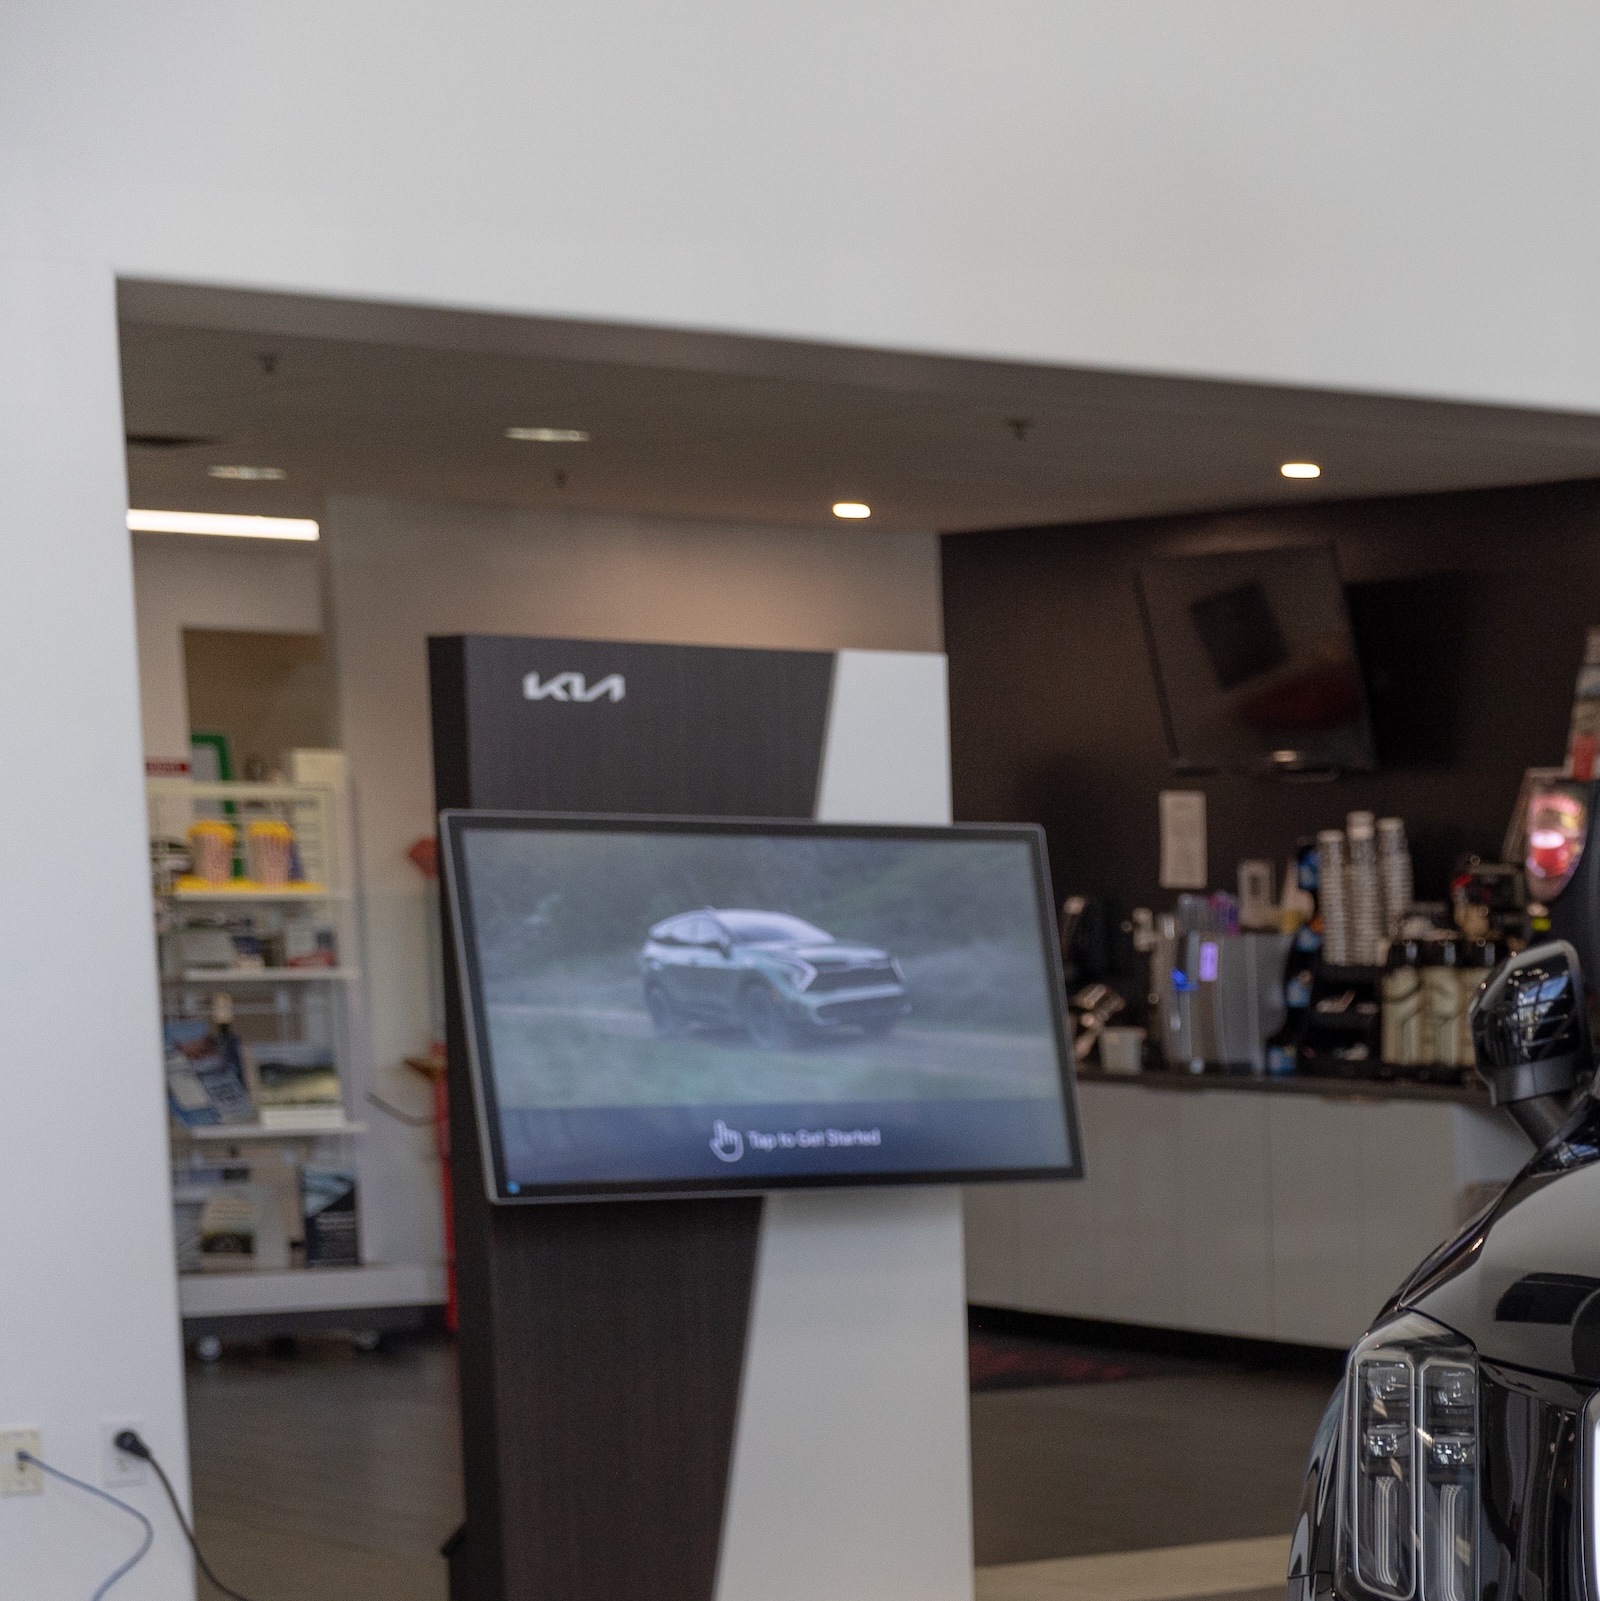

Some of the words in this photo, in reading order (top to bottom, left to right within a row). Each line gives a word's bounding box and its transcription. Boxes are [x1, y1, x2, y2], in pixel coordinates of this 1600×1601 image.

[522, 671, 626, 702] KIA
[747, 1130, 777, 1150] Tap
[777, 1131, 796, 1148] to
[796, 1129, 825, 1148] Get
[825, 1128, 881, 1148] Started
